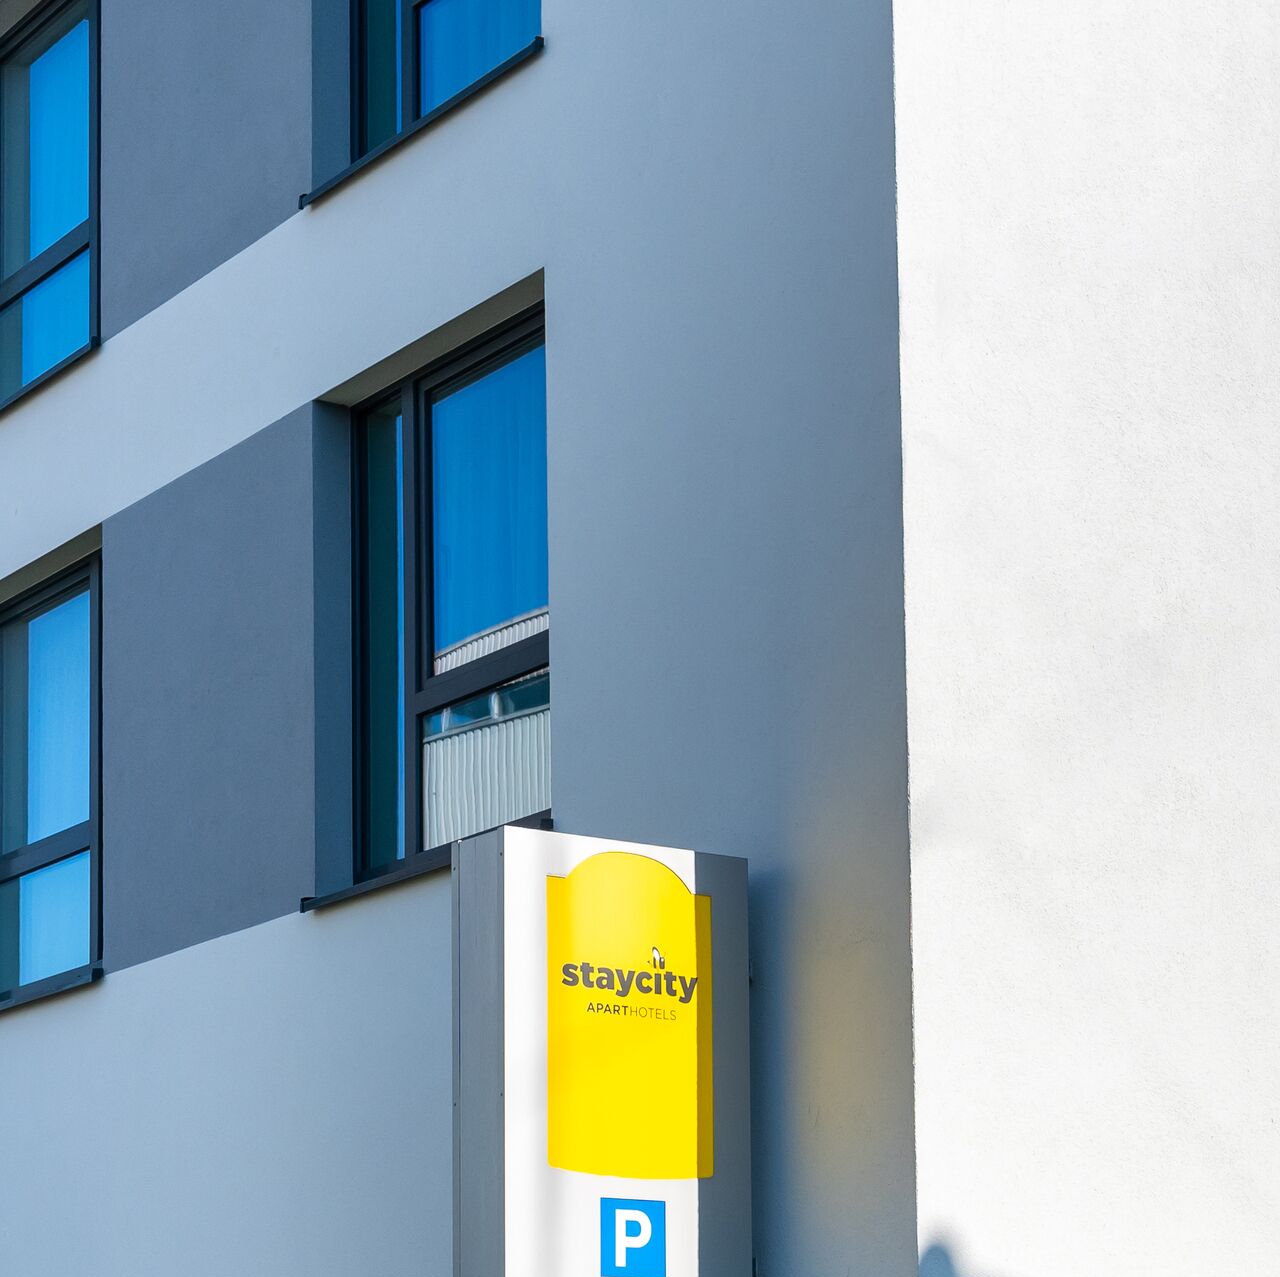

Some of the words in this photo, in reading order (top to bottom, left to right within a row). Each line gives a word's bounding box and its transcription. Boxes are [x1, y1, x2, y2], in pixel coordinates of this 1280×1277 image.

[561, 960, 699, 1004] staycity
[586, 1002, 677, 1021] APARTHOTELS
[614, 1208, 652, 1268] P
